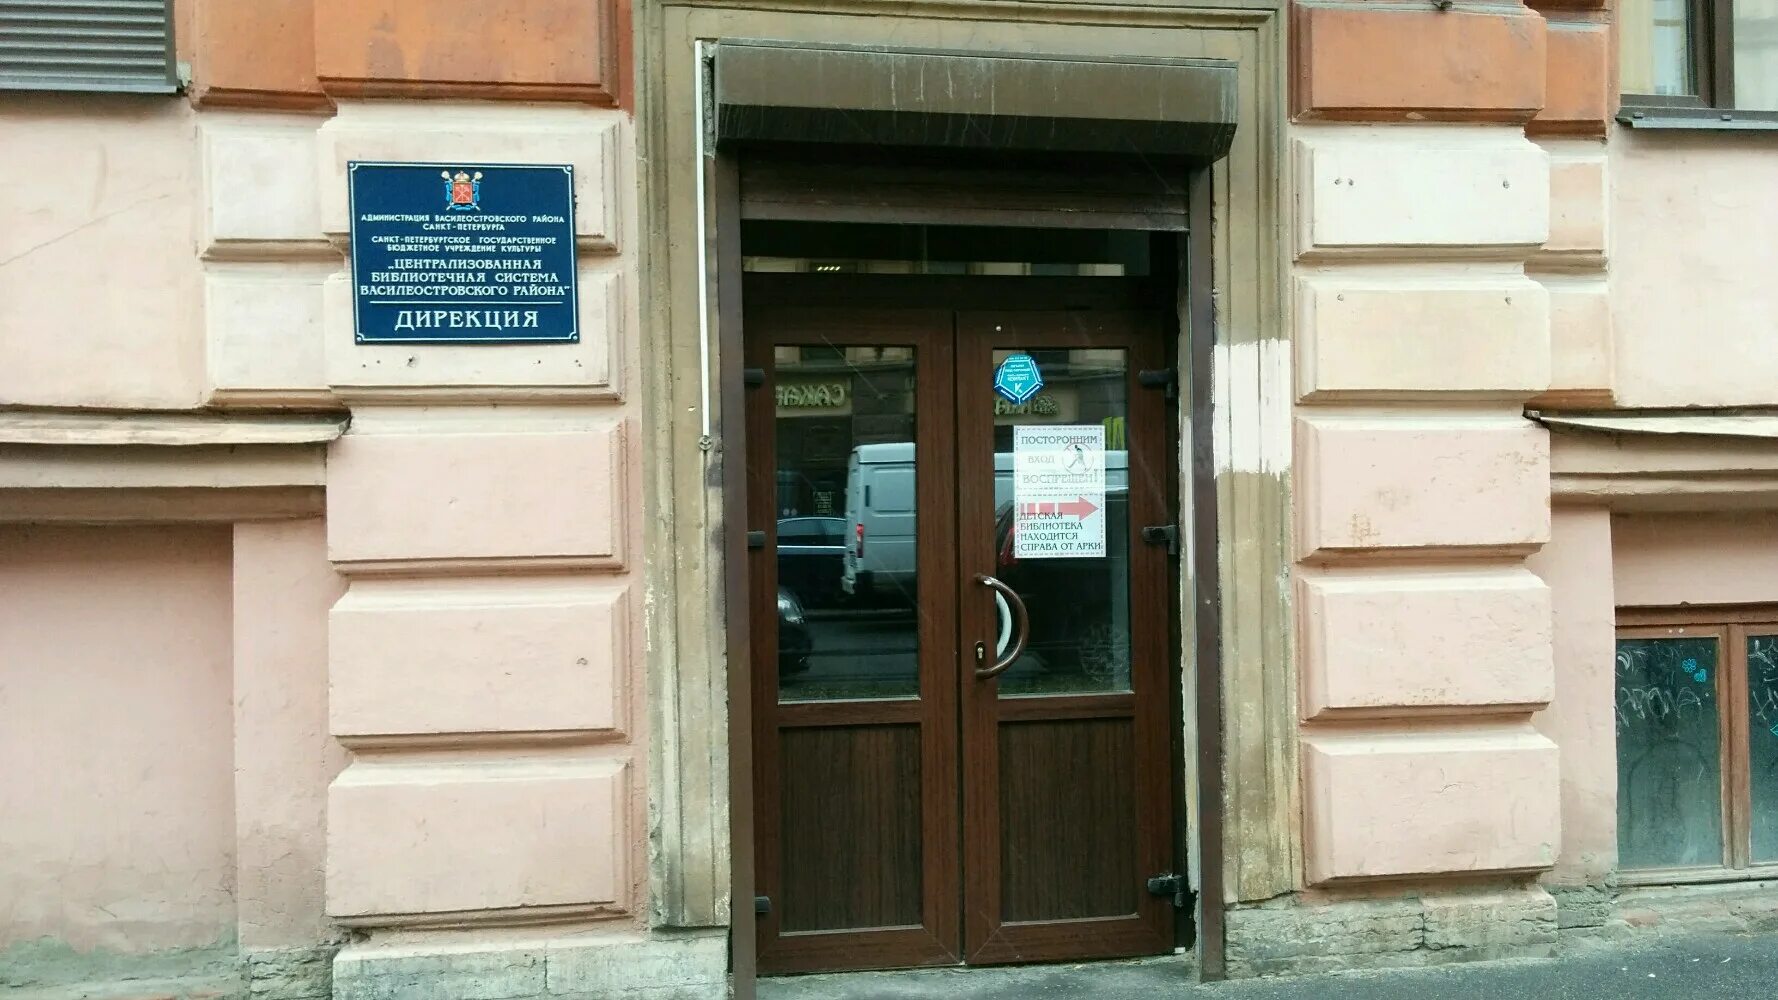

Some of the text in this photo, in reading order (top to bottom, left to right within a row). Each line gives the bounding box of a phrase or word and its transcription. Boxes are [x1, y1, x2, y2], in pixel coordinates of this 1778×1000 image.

[361, 214, 565, 223] АДМИНИСТРАЦИЯ ВАСИЛЕОСТРОВСКОГО РАЙОНА
[422, 223, 506, 231] САНКТ-ПЕТЕРБУРГА
[371, 236, 557, 245] САНКТ-ПЕТЕРБУРГСКОЕ ГОСУДАРСТВЕННОЕ
[387, 244, 542, 253] БЮДЖЕТНОЕ УЧРЕЖДЕНИЕ КУЛЬТУРЫ
[371, 272, 559, 283] БИБЛИОТЕЧНАЯ СИСТЕМА
[360, 285, 508, 296] ВАСИЛЕОСТРОВСКОГО
[394, 310, 539, 331] ДИРЕКЦИЯ
[1021, 435, 1098, 445] ПОСТОРОННИМ
[1028, 455, 1055, 464] ВХОД
[1020, 512, 1063, 521] ДЕТСКАЯ
[1020, 522, 1083, 531] БИБЛИОТЕКА
[1020, 533, 1078, 541] НАХОДИТСЯ
[1020, 543, 1058, 551] СПРАВА
[1077, 542, 1101, 550] АРКИ
